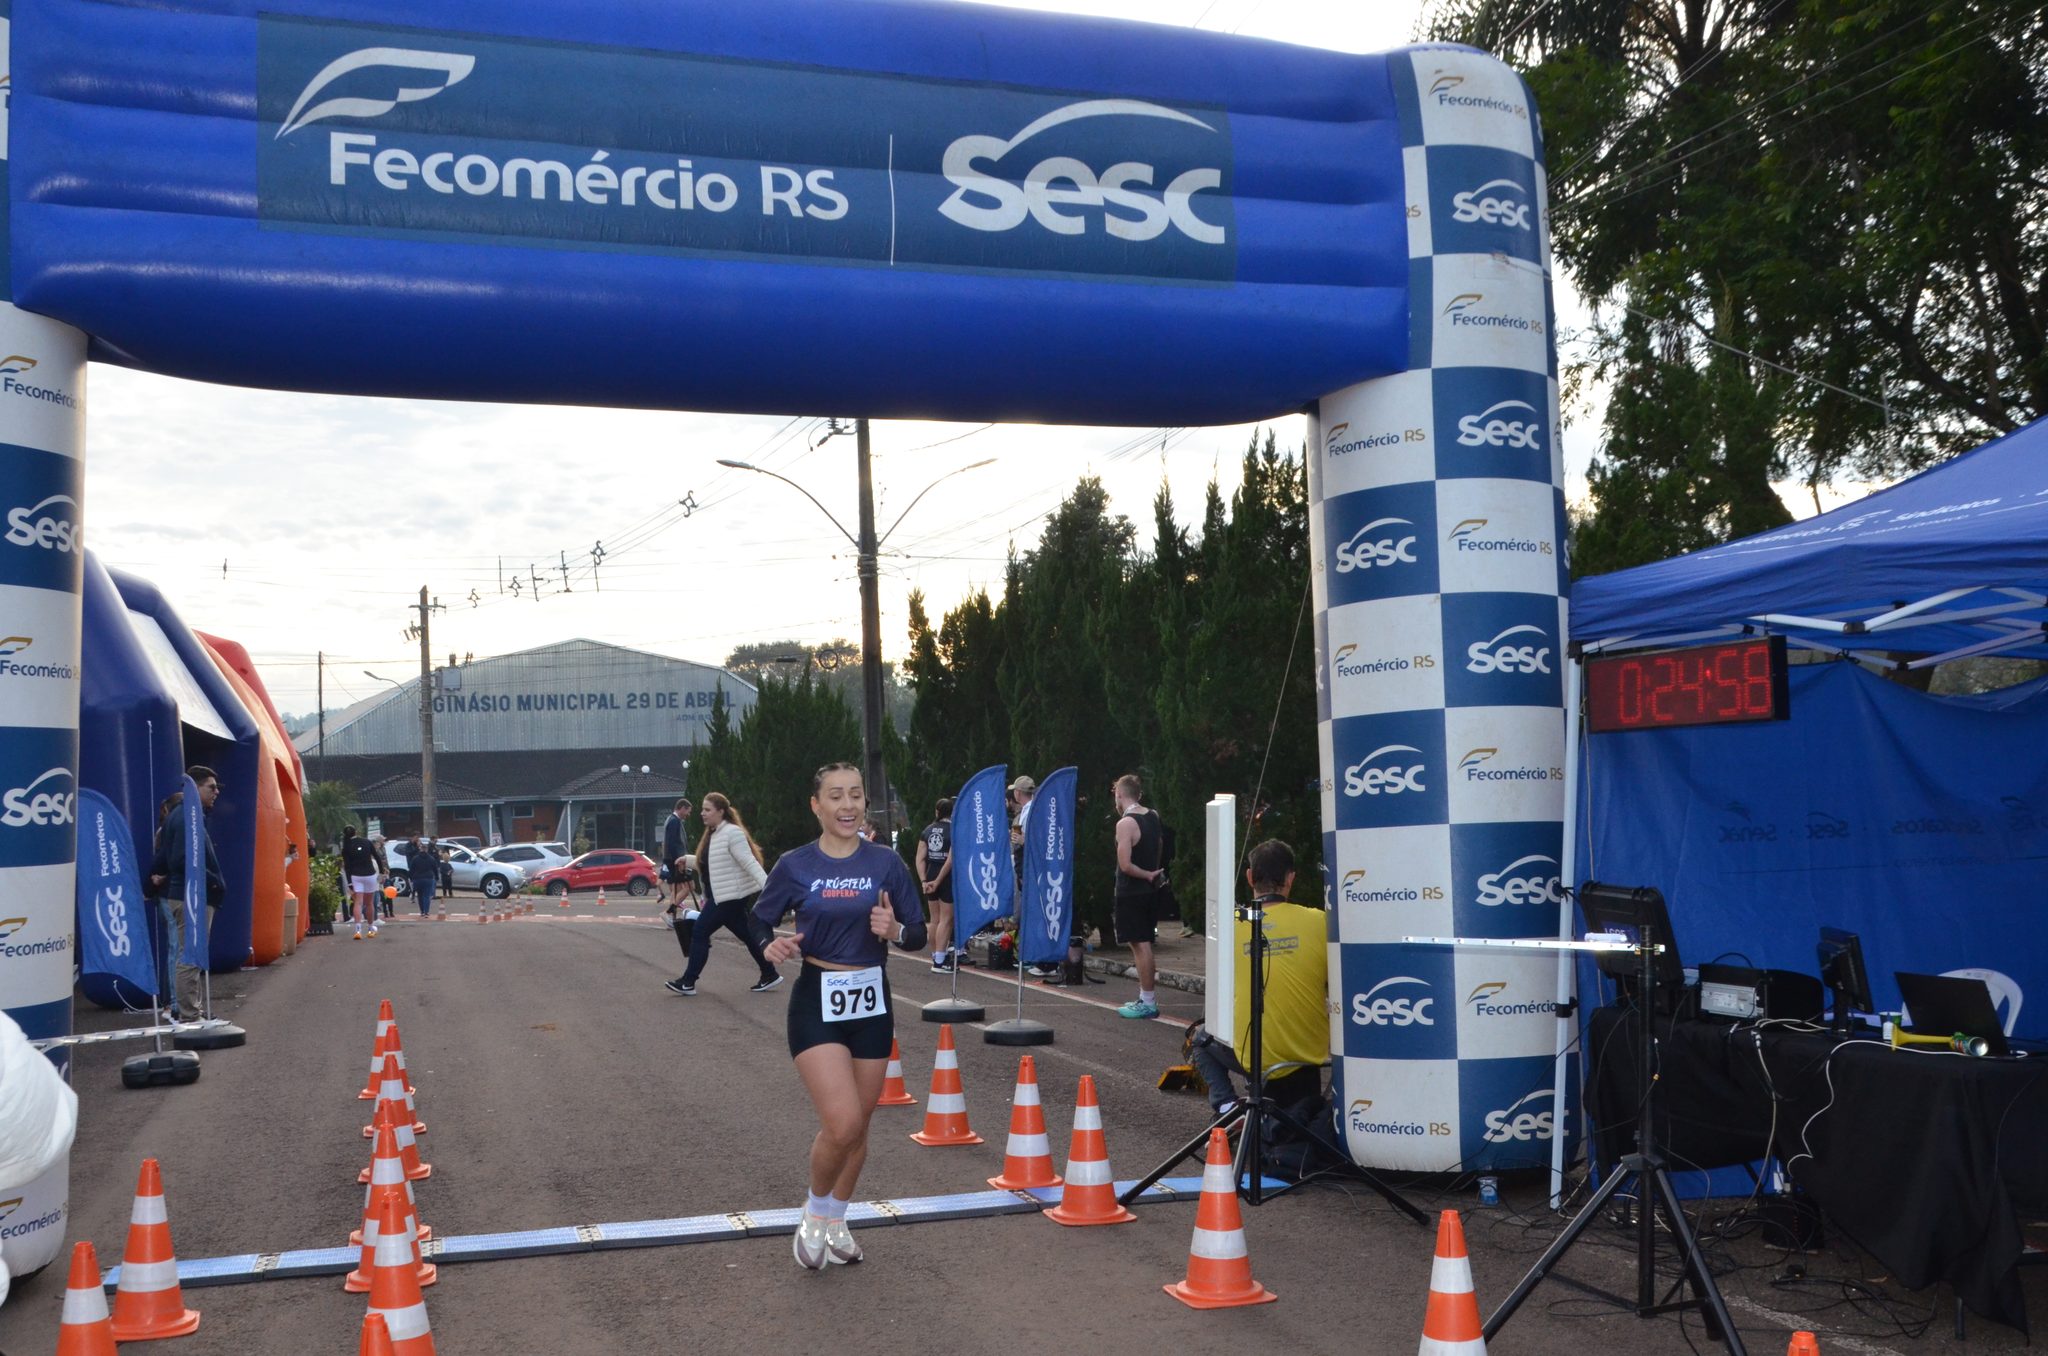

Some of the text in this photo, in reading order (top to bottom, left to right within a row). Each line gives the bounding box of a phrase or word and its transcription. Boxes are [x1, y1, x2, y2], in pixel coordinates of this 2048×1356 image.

[1439, 94, 1527, 120] Fecomércio RS
[330, 131, 849, 221] Fecomércio RS
[938, 99, 1225, 244] Sesc
[1452, 179, 1531, 231] Sesc
[1453, 313, 1543, 335] Fecomércio RS
[1457, 400, 1540, 450] Sesc
[1329, 428, 1426, 458] Fecomércio RS
[1335, 517, 1417, 574] Sesc
[1458, 538, 1537, 553] Fecomércio
[1539, 541, 1553, 555] RS
[1465, 624, 1550, 674] Sesc
[0, 660, 72, 679] Fecomércio
[1337, 655, 1435, 678] Fecomércio RS
[433, 691, 511, 713] GINÁSIO
[517, 692, 620, 711] MUNICIPAL
[626, 692, 650, 709] 29
[656, 692, 679, 709] DE
[1344, 744, 1425, 797] Sesc
[1467, 766, 1563, 781] Fecomércio RS
[973, 790, 984, 844] Fecomércio
[986, 814, 995, 842] Senac
[1045, 797, 1056, 860] Fecomércio
[95, 812, 109, 877] Fecomércio
[109, 840, 120, 874] Senac
[969, 852, 998, 911] Sesc
[1346, 888, 1417, 902] Fecomércio
[1422, 886, 1444, 900] RS
[96, 885, 130, 957] Sesc
[830, 986, 876, 1016] 979
[1352, 976, 1434, 1026] Sesc
[1476, 1000, 1558, 1016] Fecomércio
[1353, 1117, 1424, 1136] Fecomércio
[1429, 1122, 1451, 1137] RS
[0, 1208, 61, 1240] ecomércio
